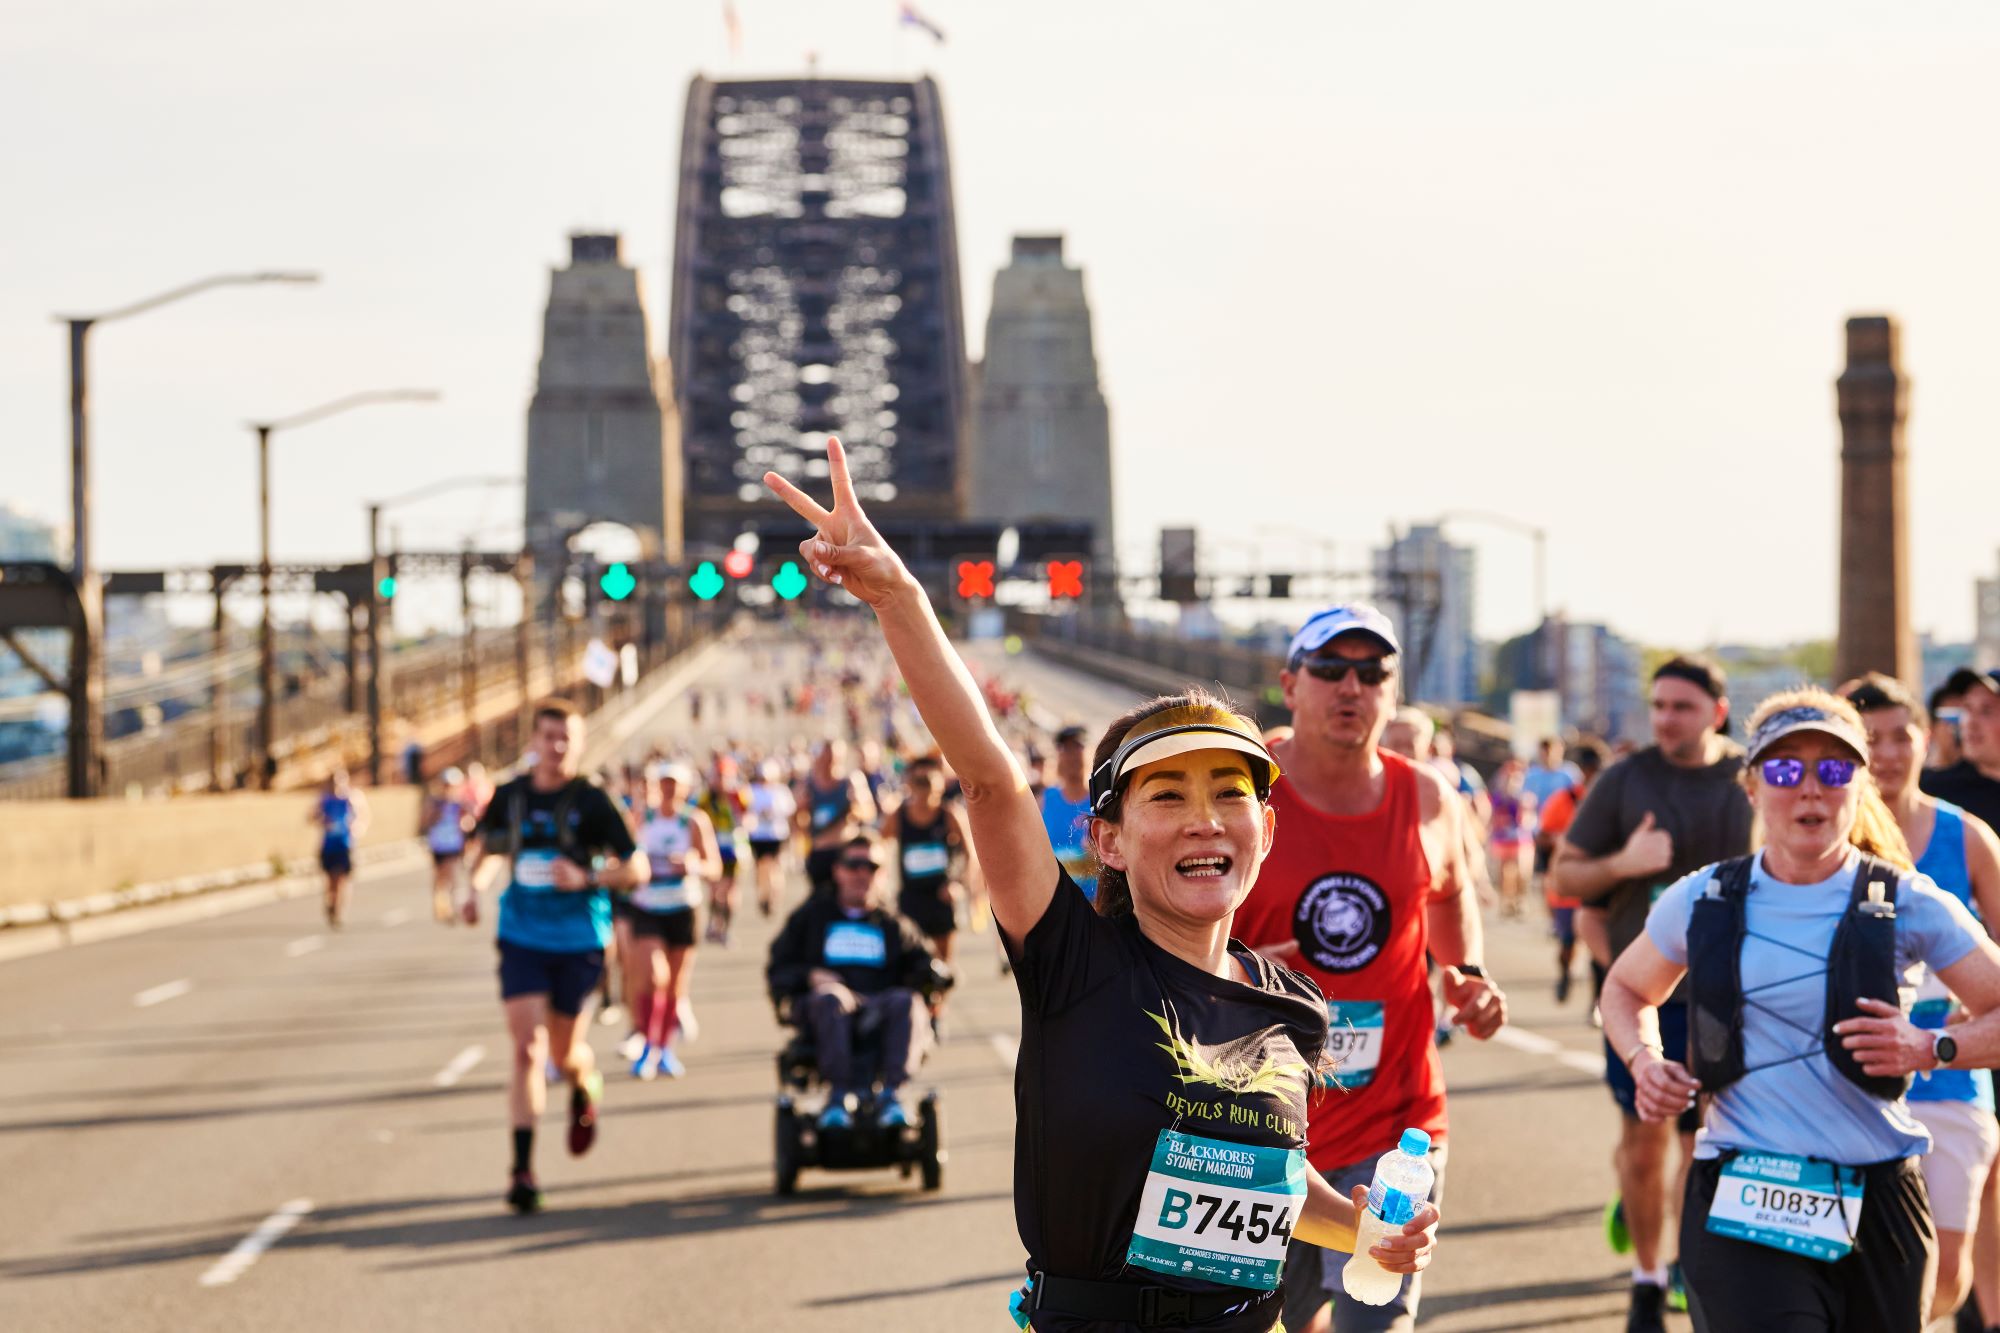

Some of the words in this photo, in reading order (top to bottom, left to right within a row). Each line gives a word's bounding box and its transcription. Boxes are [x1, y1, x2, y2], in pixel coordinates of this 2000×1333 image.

[1314, 943, 1378, 968] JOGGERS
[1166, 1092, 1223, 1120] DEVILS
[1229, 1104, 1259, 1128] RUN
[1170, 1140, 1255, 1165] BLACKMORES
[1165, 1153, 1204, 1172] SYDNEY
[1206, 1161, 1253, 1179] MARATHON
[1741, 1184, 1837, 1218] C10837
[1158, 1188, 1291, 1246] B7454
[1755, 1212, 1811, 1227] BELINDA
[1138, 1254, 1177, 1266] BLACKMORES
[1179, 1247, 1211, 1258] BLACKMORES
[1212, 1253, 1230, 1261] SYDNEY
[1230, 1256, 1255, 1265] MARATHON
